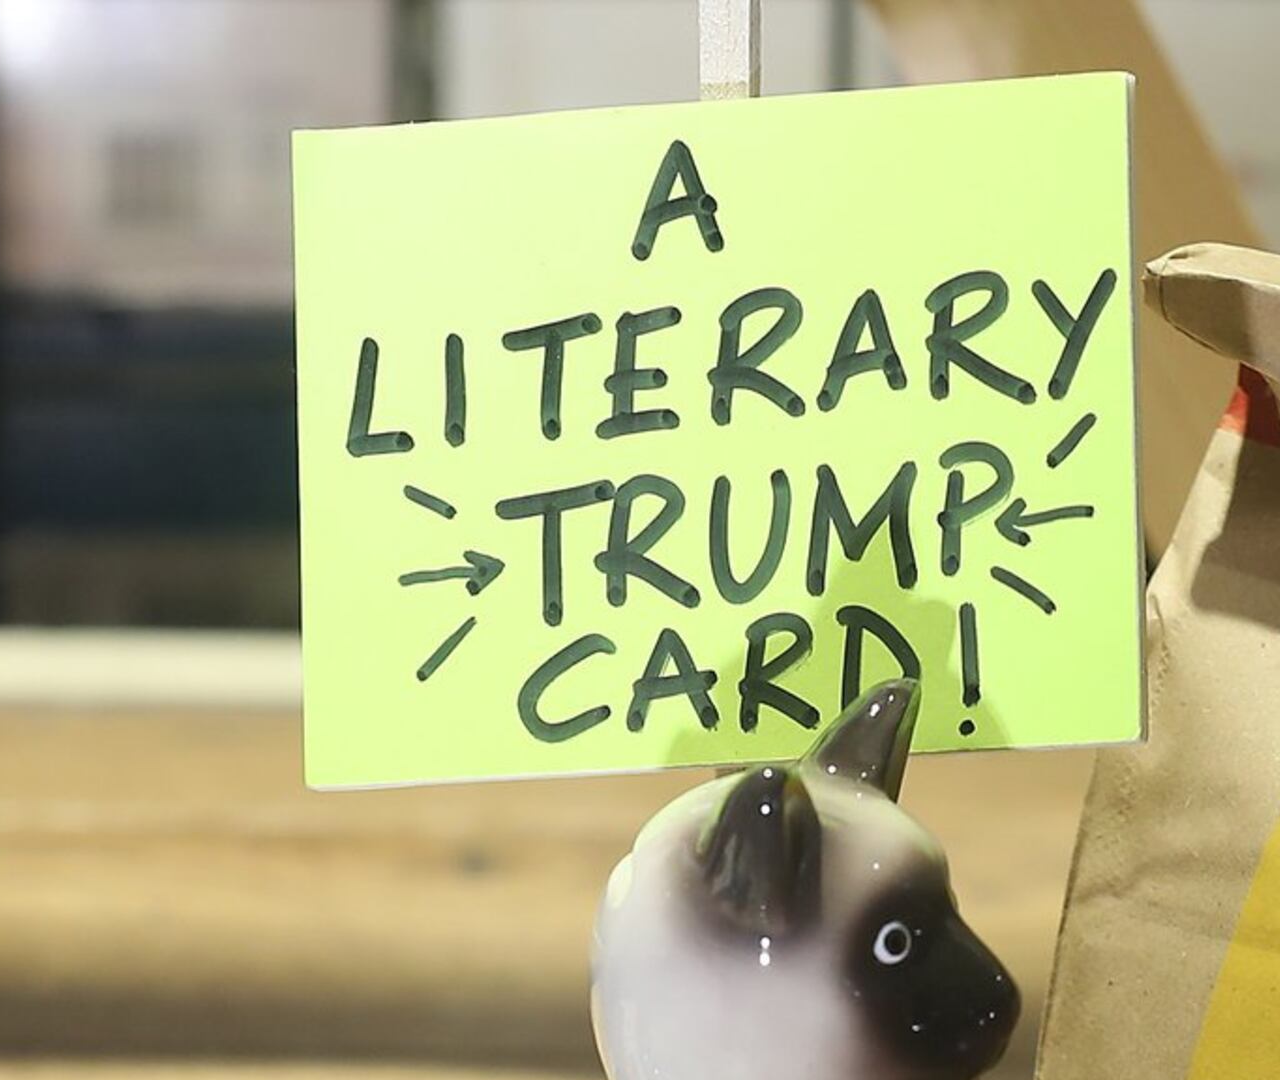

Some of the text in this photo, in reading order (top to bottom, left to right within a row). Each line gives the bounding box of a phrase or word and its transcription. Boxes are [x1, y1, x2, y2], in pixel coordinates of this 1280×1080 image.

[631, 139, 725, 262] A
[347, 268, 1117, 458] LITERARY
[496, 441, 1015, 627] TRUMP
[517, 603, 980, 743] CARD!
